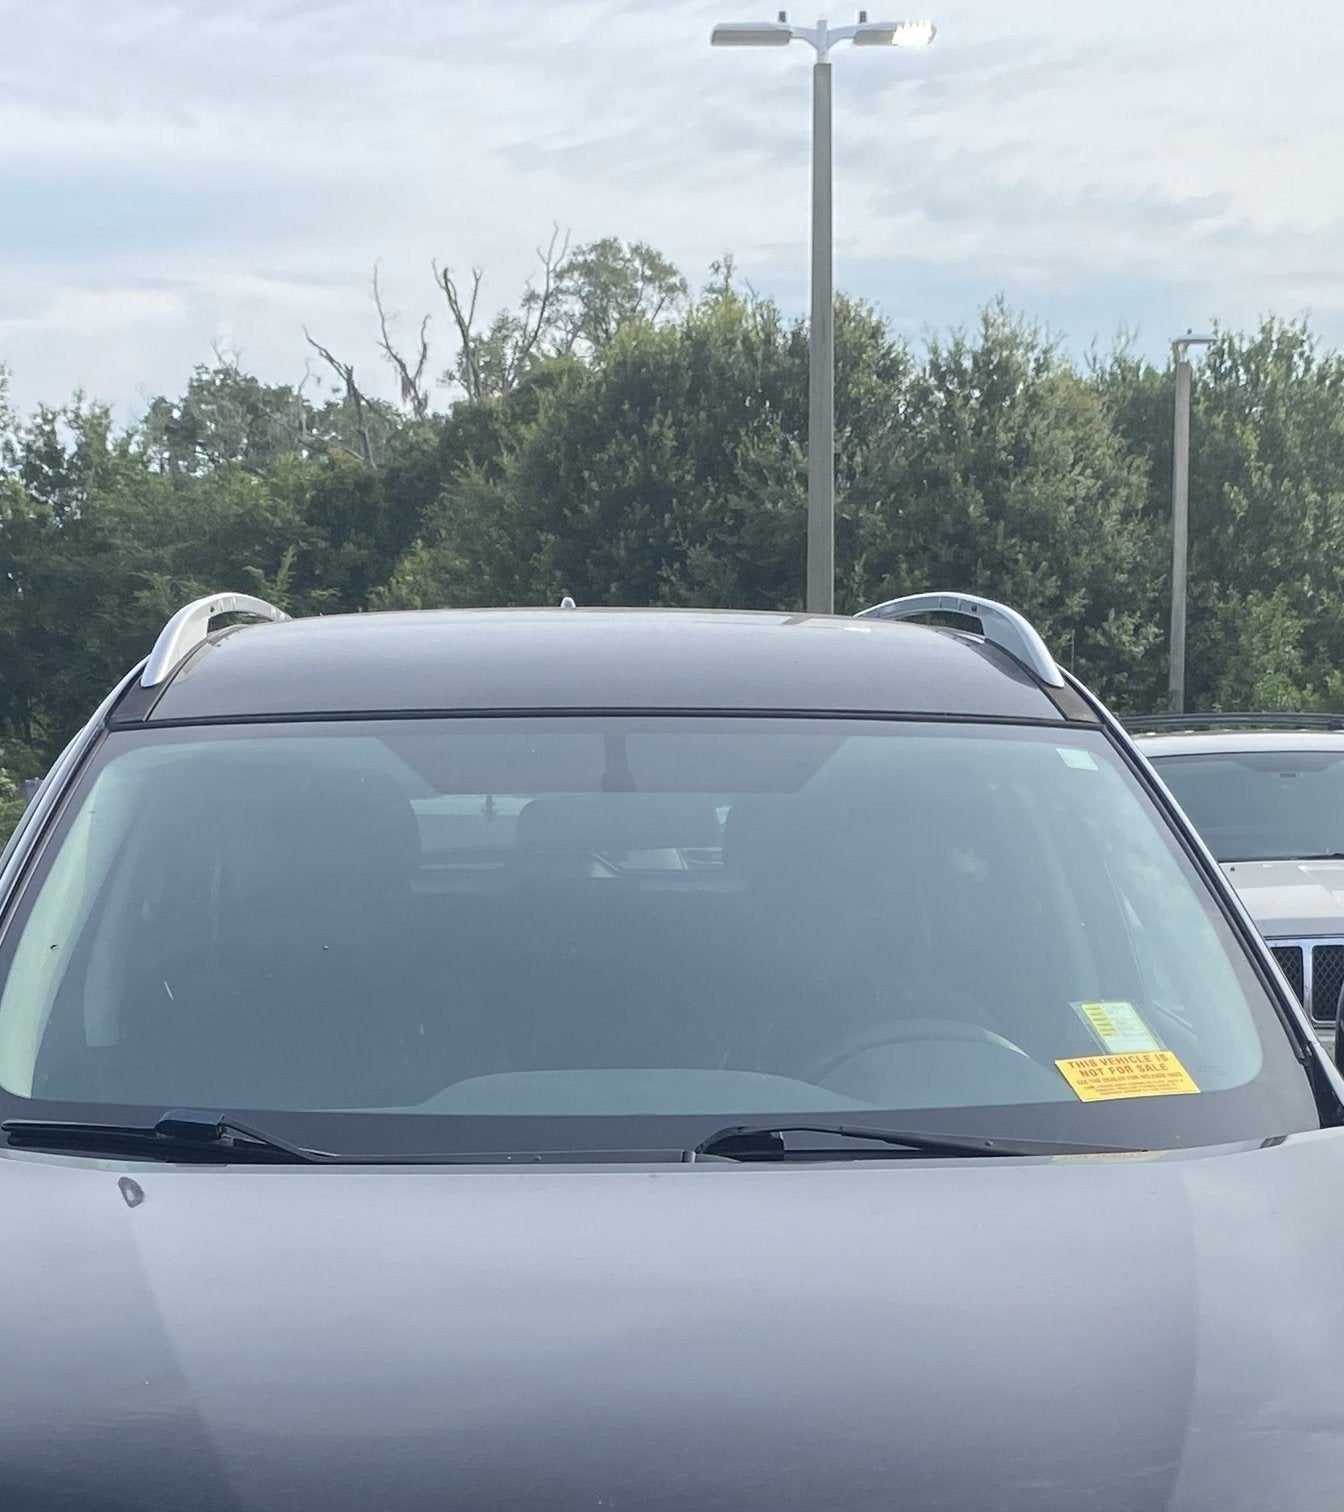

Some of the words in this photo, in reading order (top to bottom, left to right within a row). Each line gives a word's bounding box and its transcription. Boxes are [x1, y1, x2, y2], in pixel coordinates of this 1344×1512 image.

[1068, 1059, 1097, 1069] THIS
[1099, 1055, 1154, 1066] VEHICLE
[1155, 1053, 1169, 1062] IS
[1078, 1068, 1106, 1078] NOT
[1108, 1065, 1134, 1075] FOR
[1138, 1063, 1169, 1073] SALE
